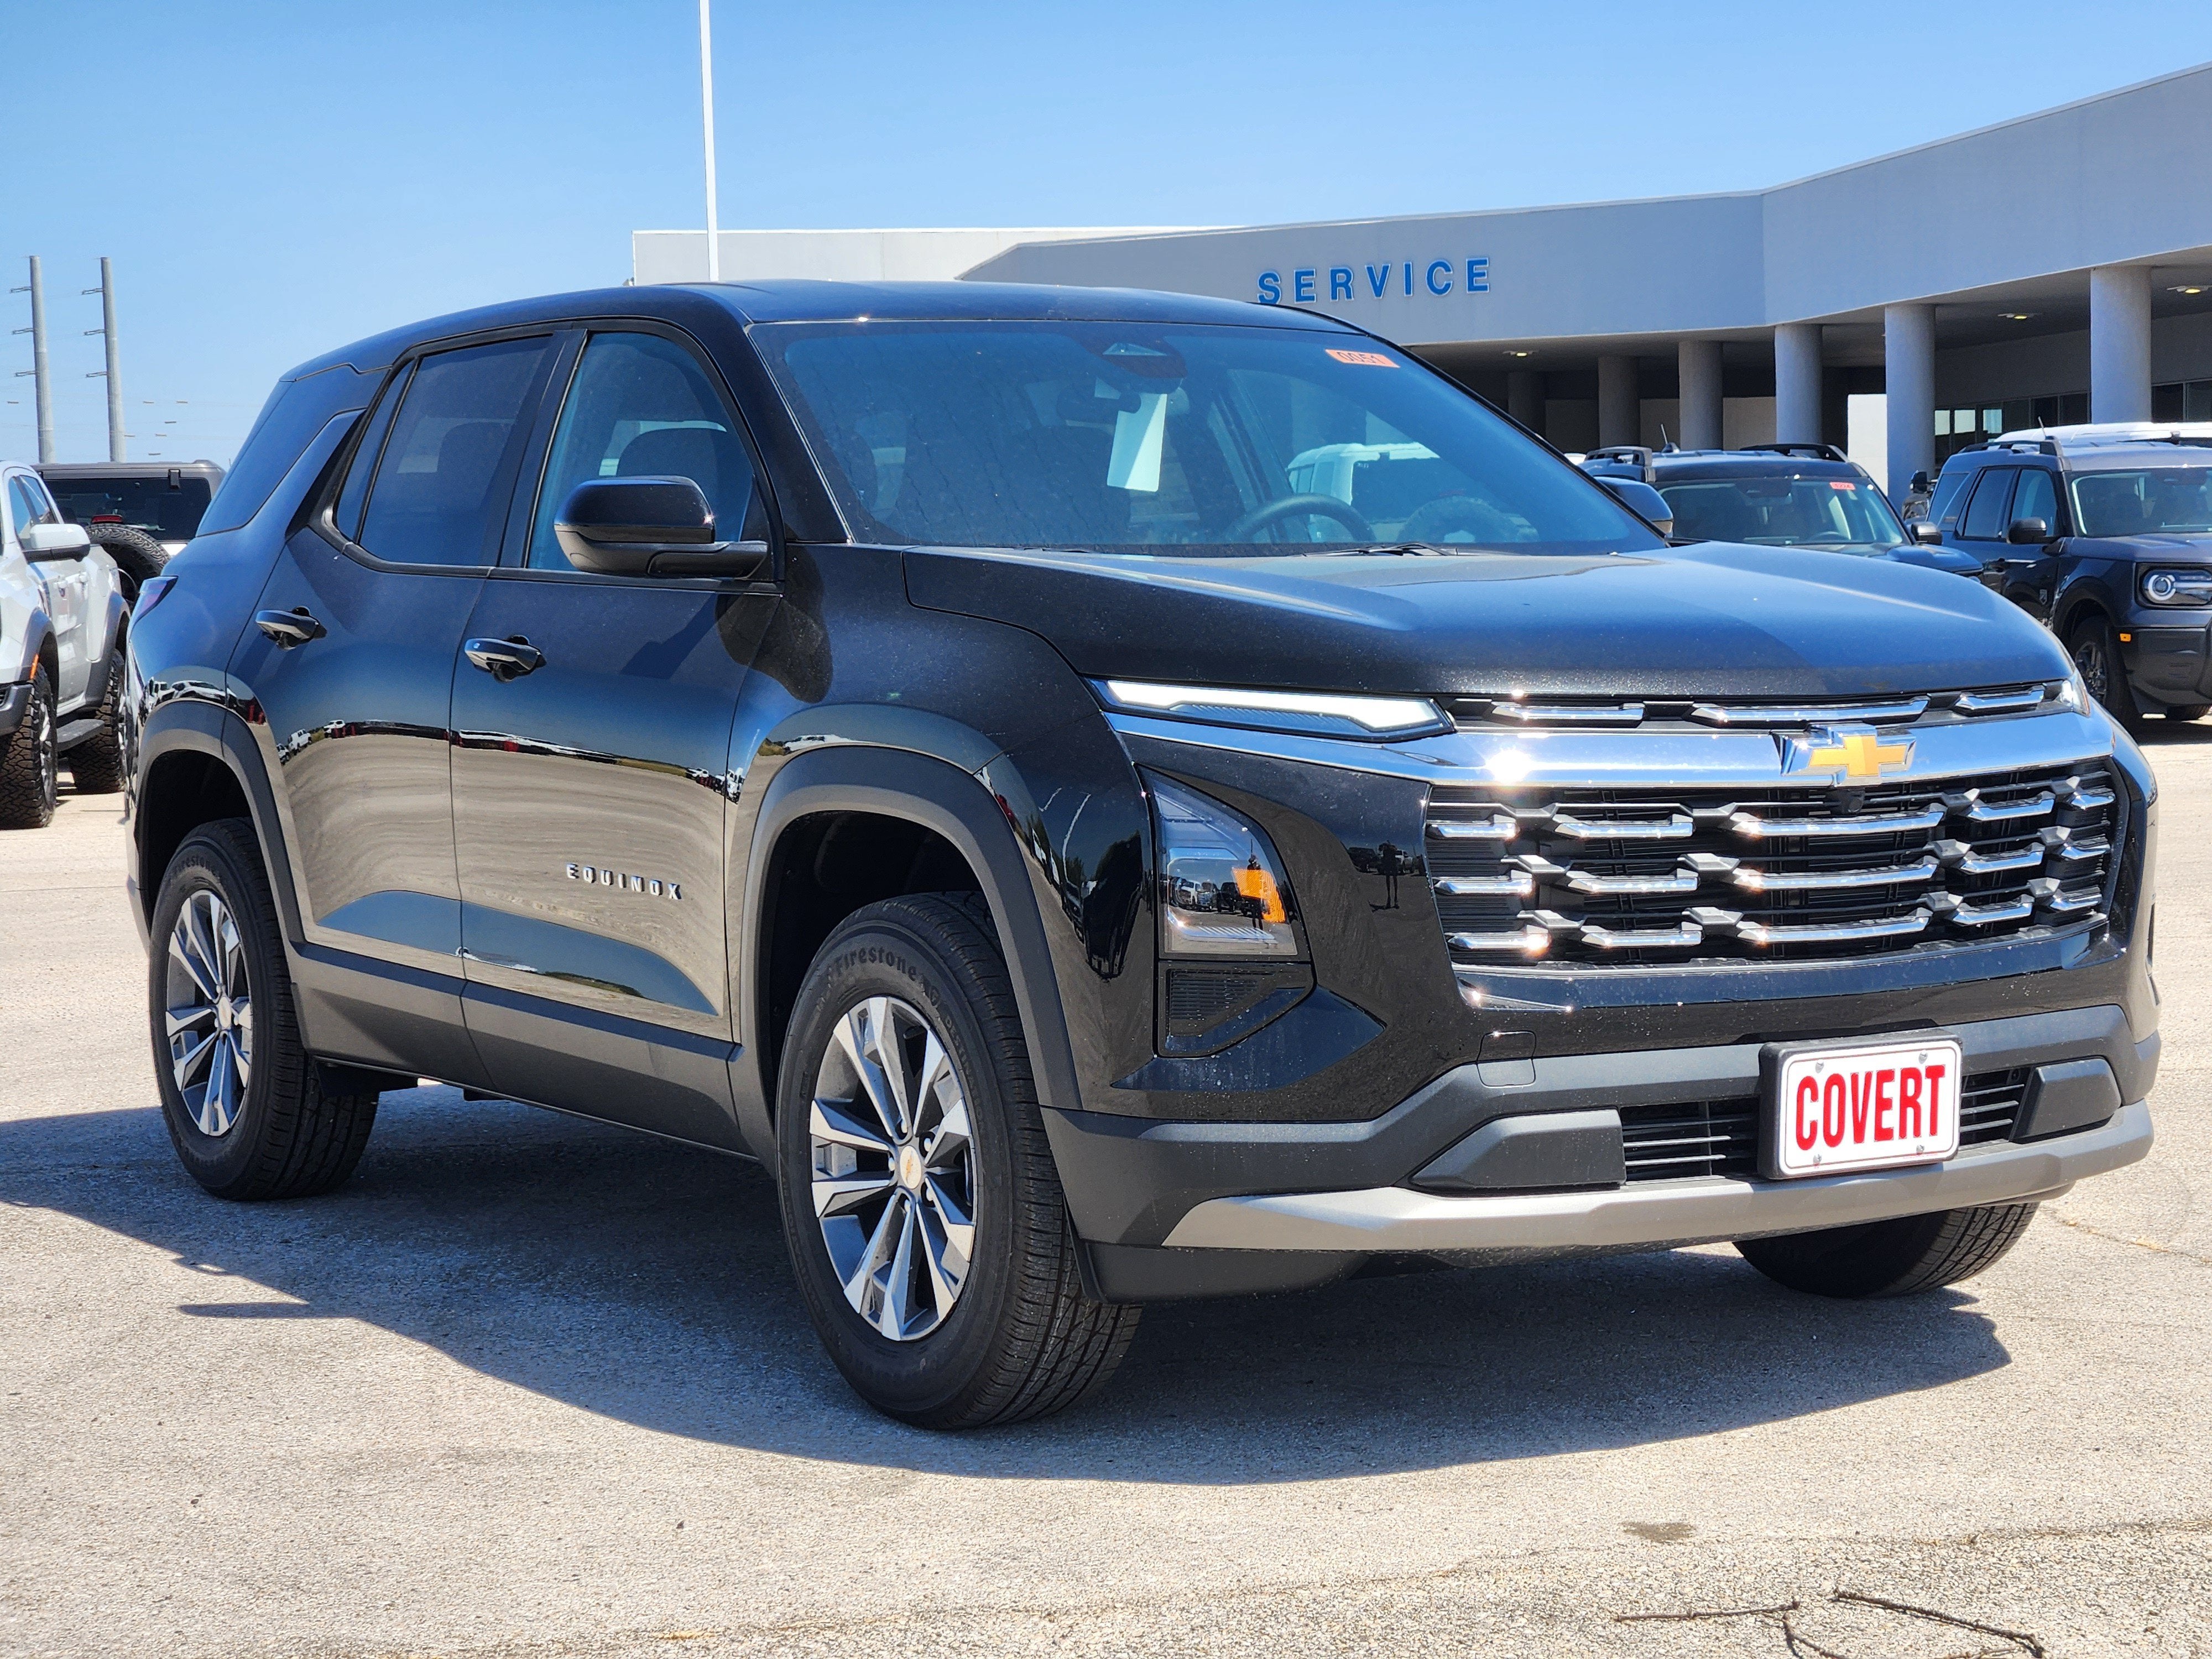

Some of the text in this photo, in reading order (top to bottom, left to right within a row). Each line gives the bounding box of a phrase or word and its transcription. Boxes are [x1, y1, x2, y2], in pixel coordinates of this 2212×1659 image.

[1257, 258, 1490, 304] SERVICE
[566, 863, 682, 900] EQUINOX
[834, 945, 917, 982] Firestone
[1796, 1065, 1945, 1151] COVERT
